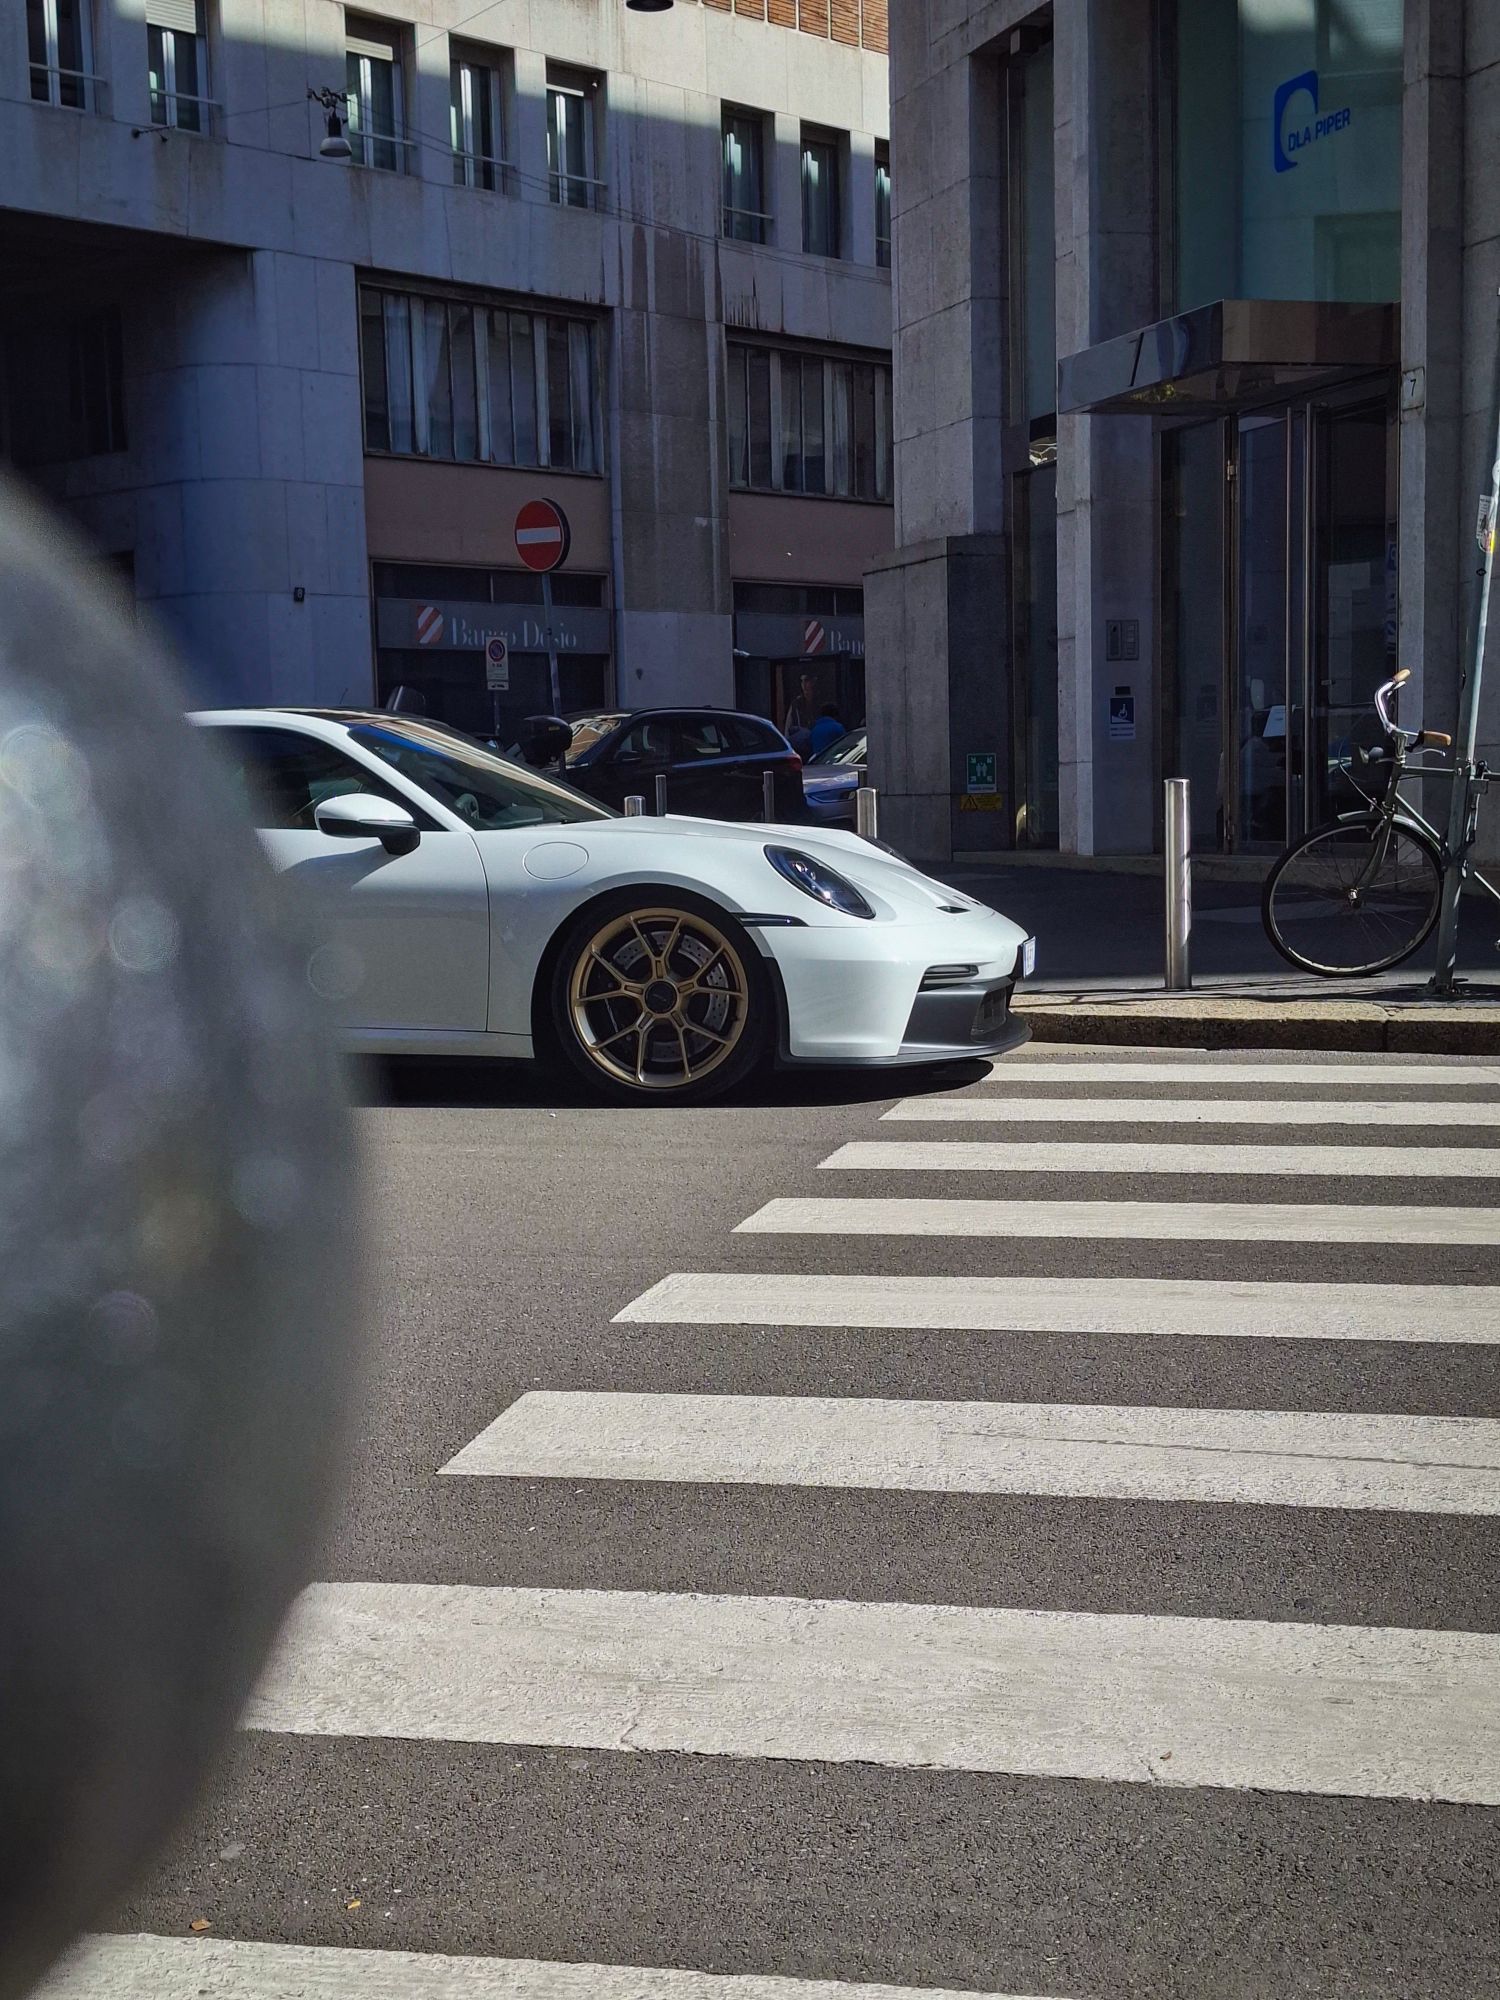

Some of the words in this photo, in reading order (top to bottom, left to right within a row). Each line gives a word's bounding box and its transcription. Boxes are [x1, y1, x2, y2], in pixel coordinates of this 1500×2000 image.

[1288, 126, 1311, 152] DLA
[1316, 107, 1350, 140] PIPER
[1410, 378, 1417, 397] 7
[452, 617, 516, 645] Bano
